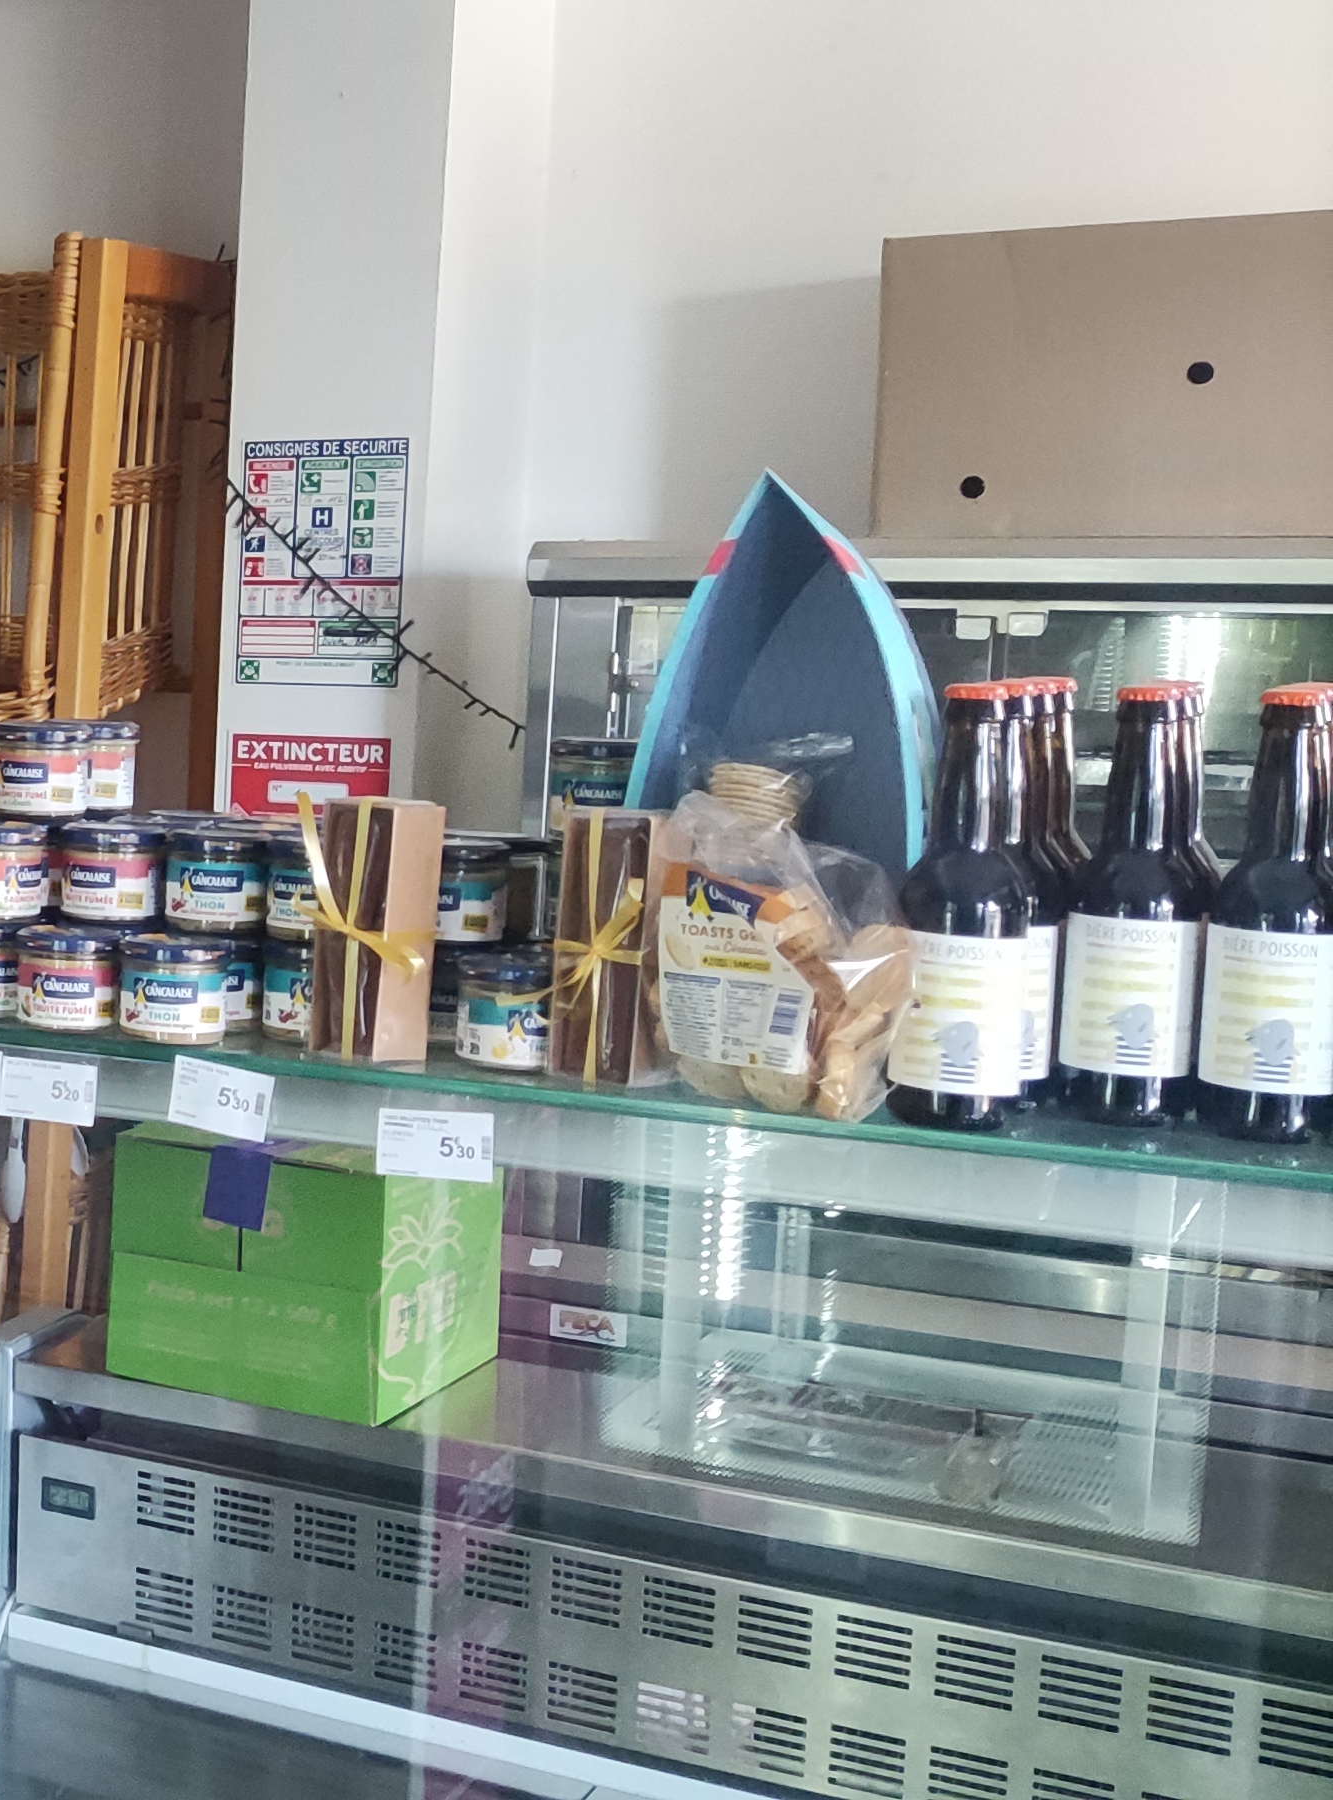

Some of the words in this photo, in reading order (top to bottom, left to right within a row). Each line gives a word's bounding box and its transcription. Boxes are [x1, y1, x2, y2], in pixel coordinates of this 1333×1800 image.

[247, 442, 320, 457] CONSIGNES
[323, 442, 340, 456] DE
[343, 440, 408, 455] SECURITE
[315, 510, 329, 526] H
[237, 740, 384, 764] EXTINCTEUR
[315, 764, 336, 773] AVEC
[194, 900, 226, 910] THON
[680, 923, 734, 939] TOASTS
[1085, 922, 1116, 939] BIÈRE
[1121, 927, 1178, 944] POISSON
[1223, 935, 1256, 954] BIÈRE
[1259, 940, 1319, 958] POISSON
[61, 1004, 93, 1015] FUMÉE
[148, 1011, 181, 1022] THON
